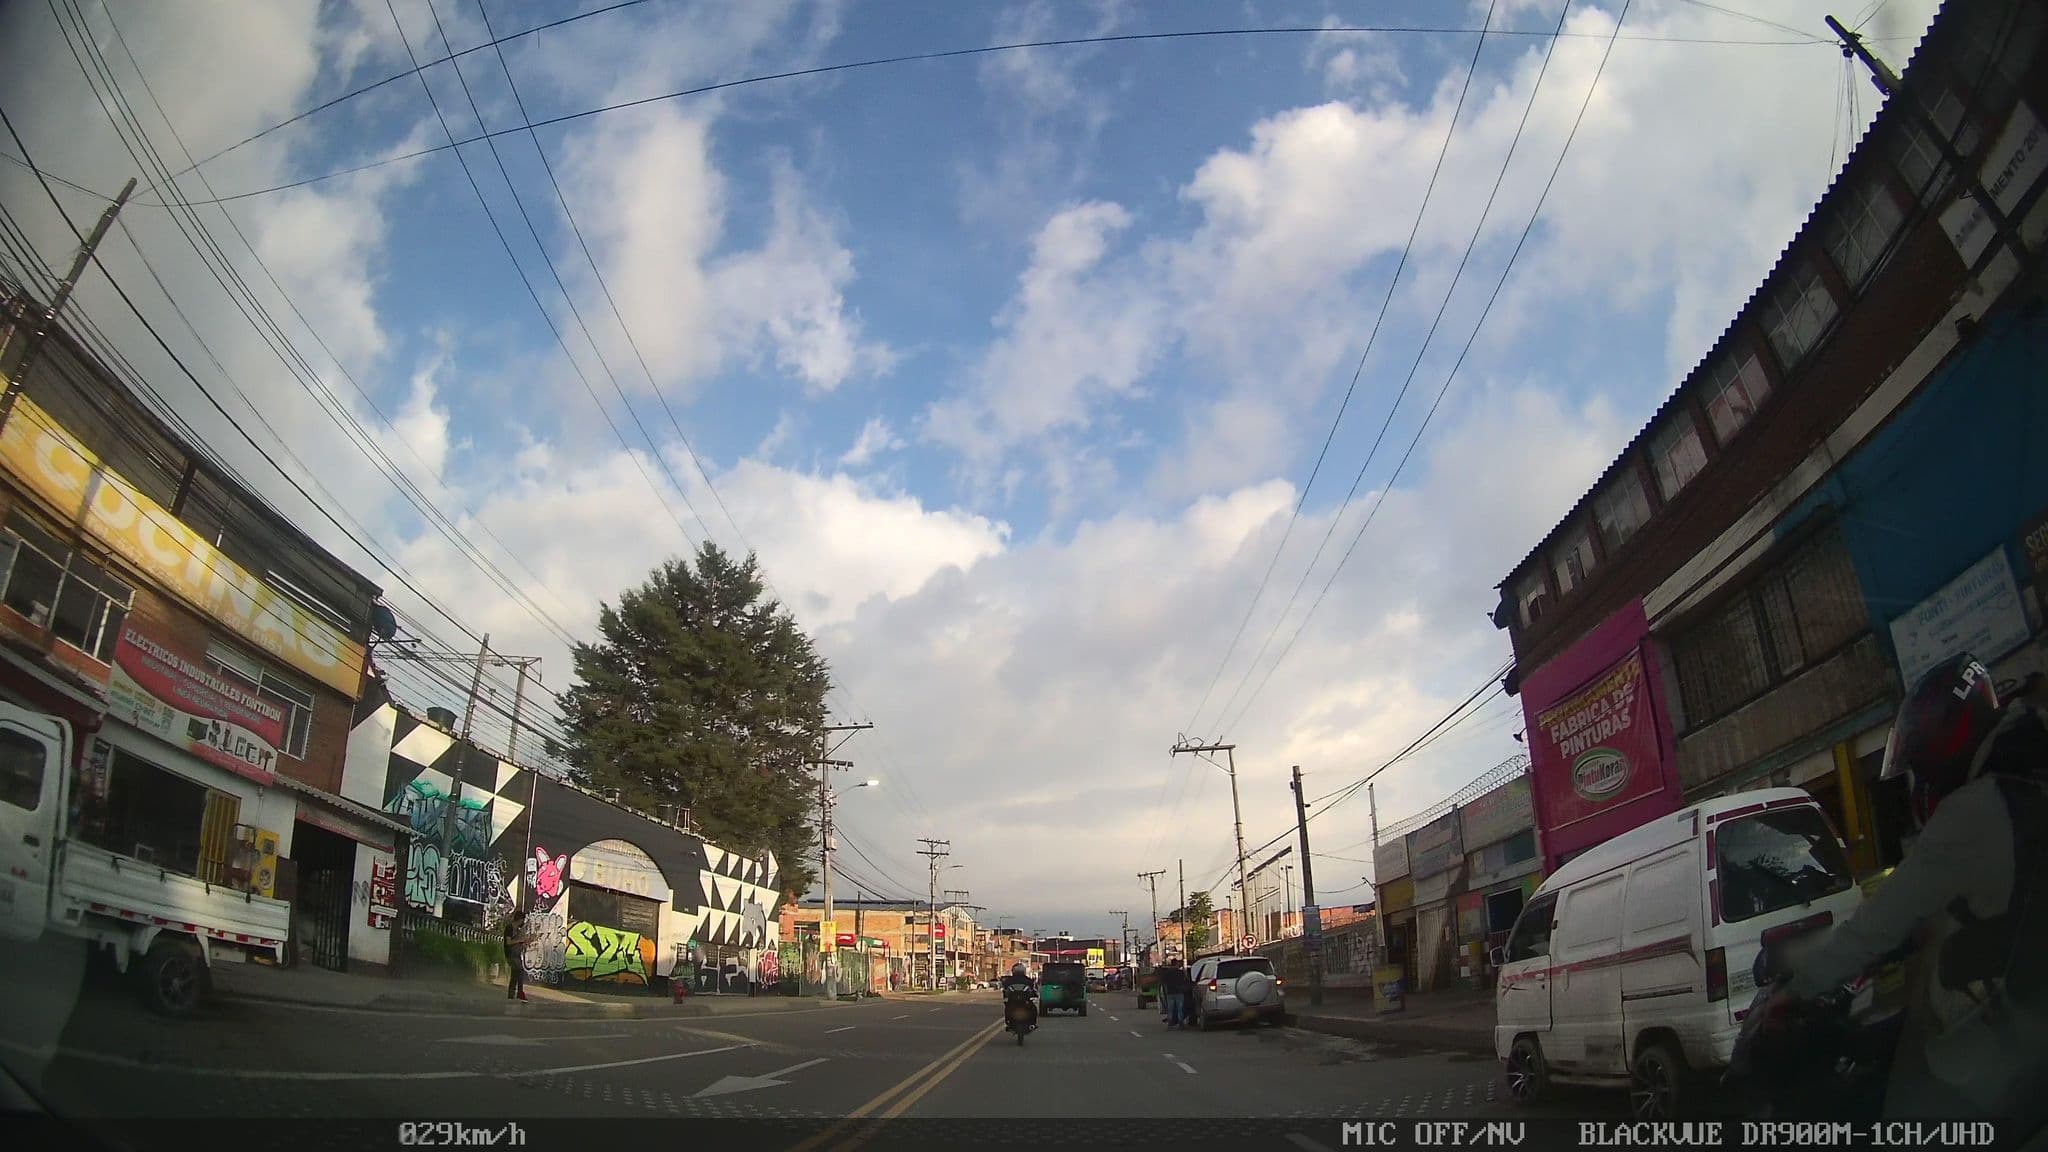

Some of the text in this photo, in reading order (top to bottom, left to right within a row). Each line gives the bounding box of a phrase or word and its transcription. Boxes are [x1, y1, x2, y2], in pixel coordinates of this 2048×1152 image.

[124, 628, 178, 669] ELECTRICOS
[179, 659, 241, 701] INDUSTRIALES
[241, 694, 281, 722] FONTIBON
[1612, 682, 1635, 711] DE
[1559, 707, 1632, 760] PINTURAS
